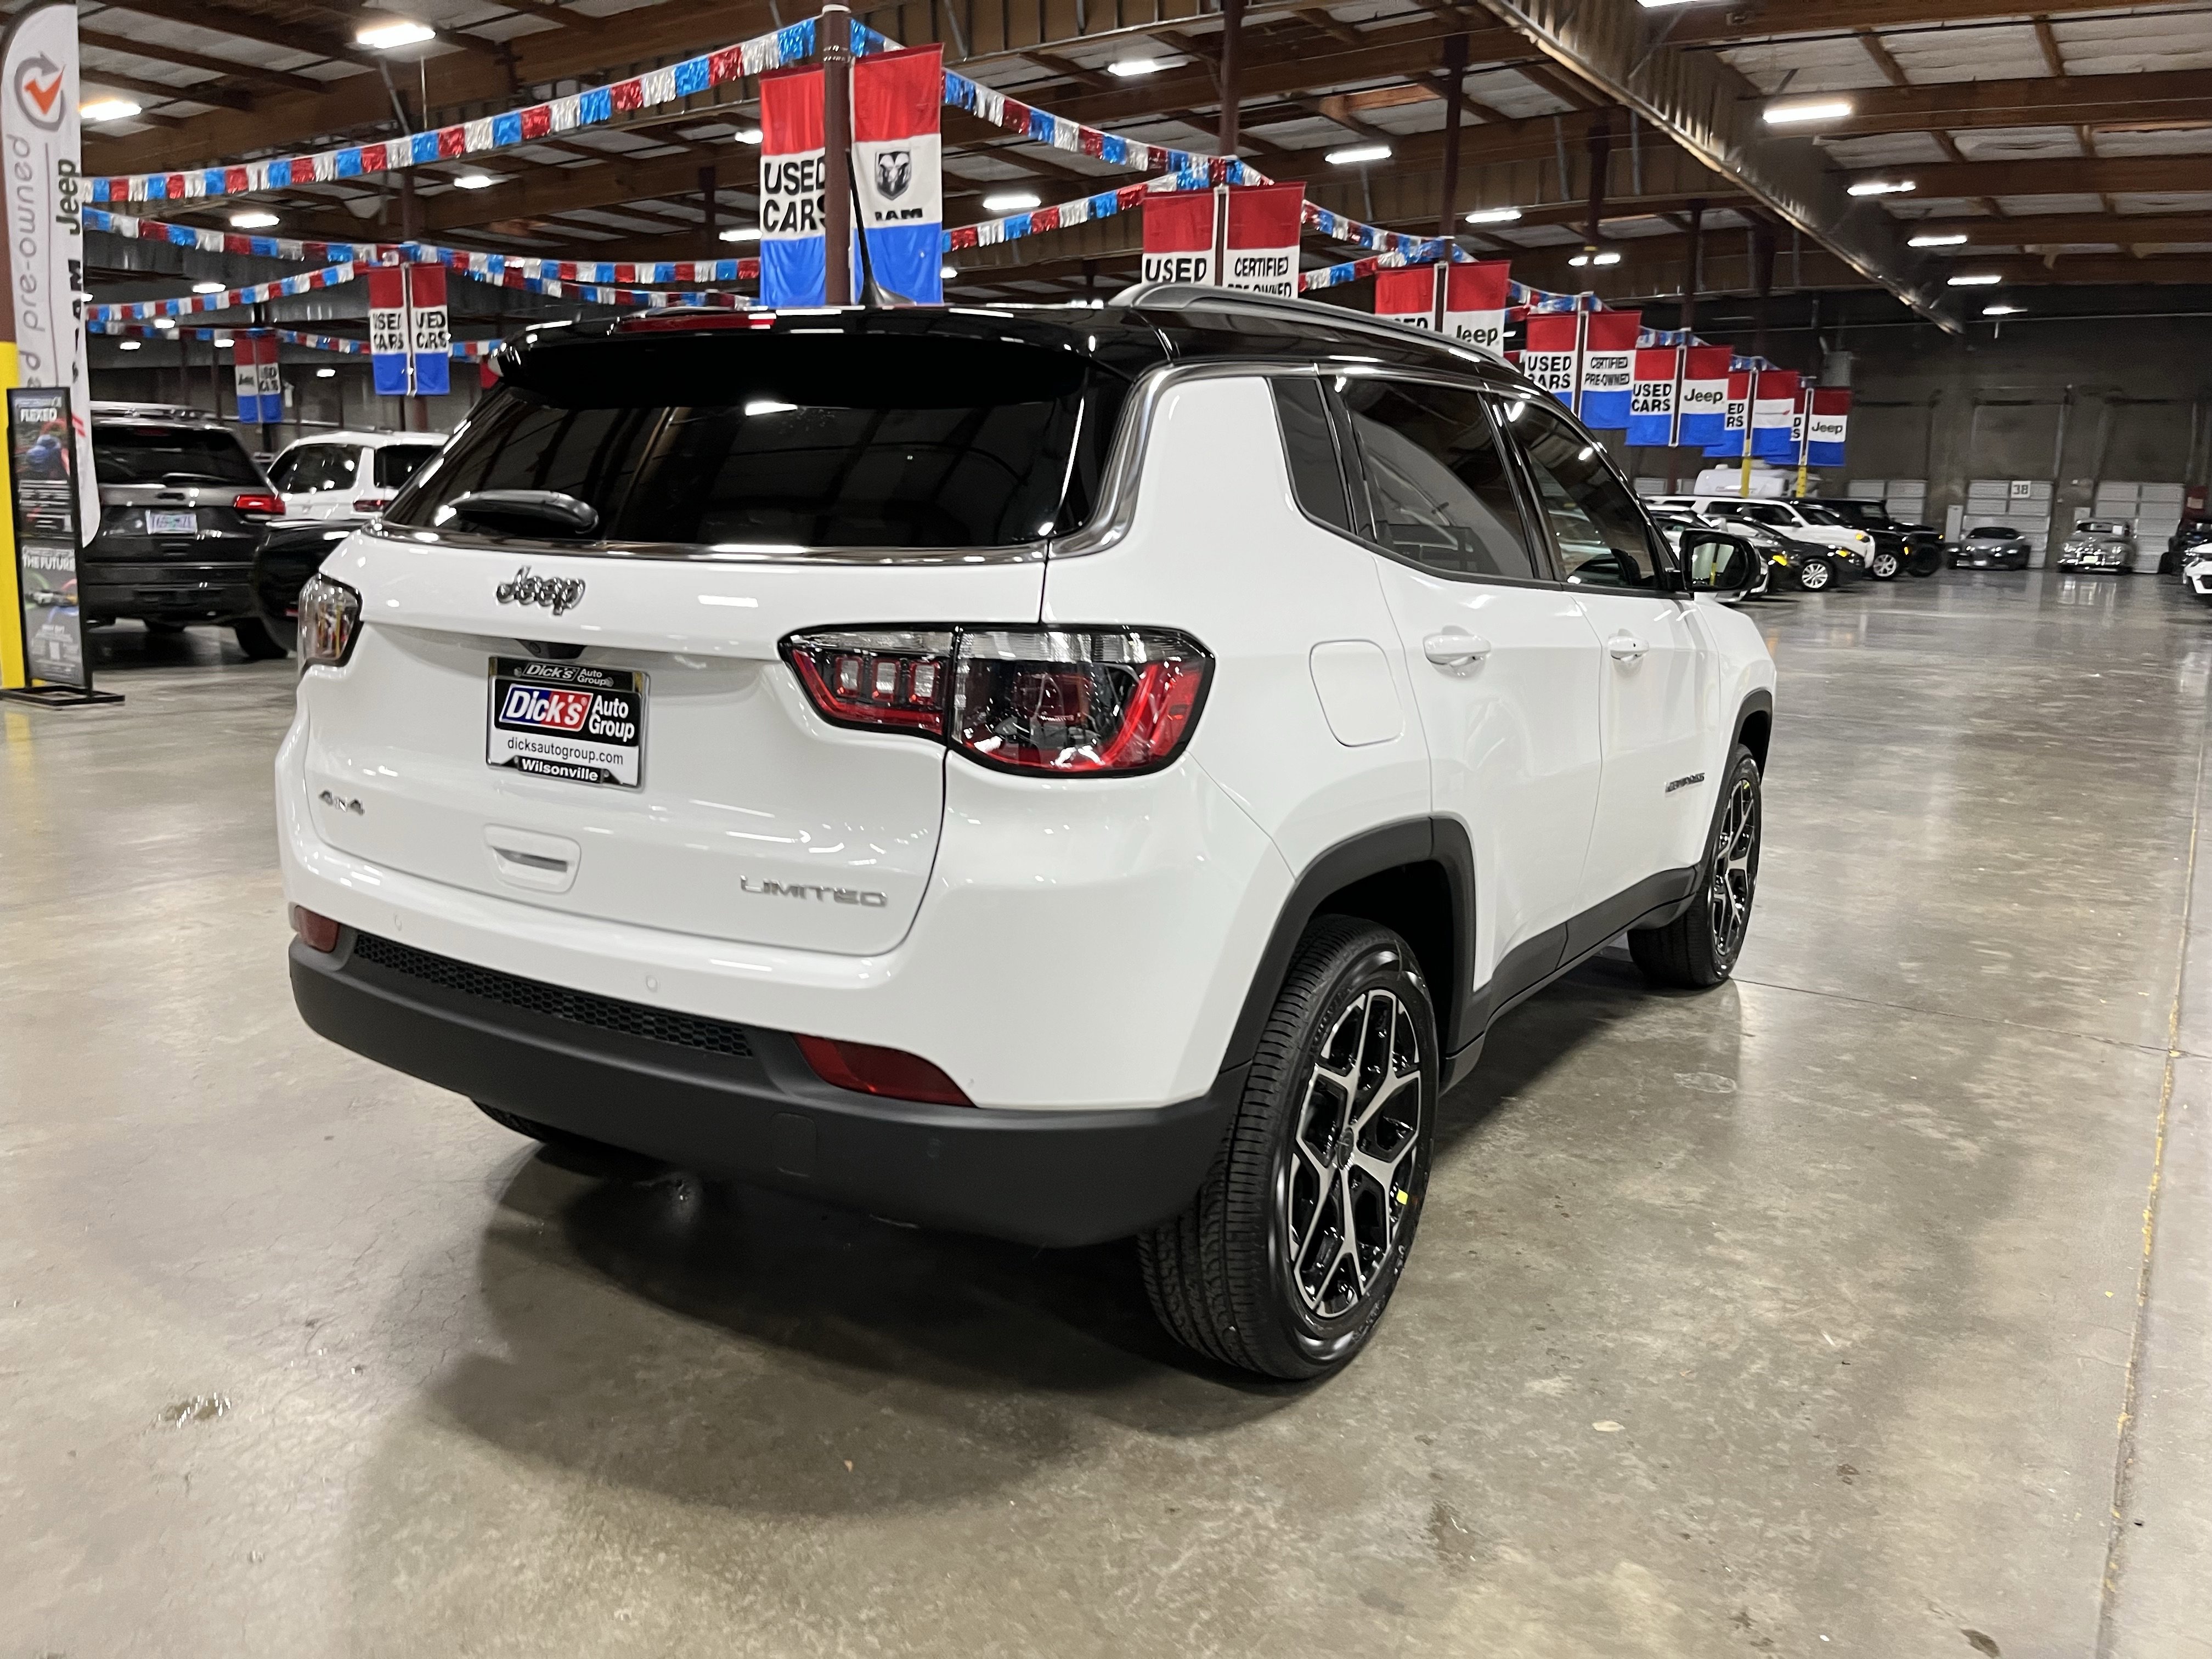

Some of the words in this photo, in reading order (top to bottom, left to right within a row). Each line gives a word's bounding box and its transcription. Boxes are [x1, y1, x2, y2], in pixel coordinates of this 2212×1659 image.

[55, 159, 81, 236] Jeep
[7, 134, 46, 332] pre-owned
[1145, 258, 1207, 283] USED
[1234, 256, 1289, 276] CERTIFIED
[68, 259, 81, 353] AM
[1528, 356, 1571, 371] USED
[1633, 383, 1672, 397] USED
[1684, 388, 1724, 404] Jeep
[1632, 398, 1671, 412] CARS
[1812, 421, 1843, 435] Jeep
[2013, 484, 2029, 494] 38
[496, 565, 586, 616] Jeep
[526, 664, 574, 679] Dick's
[577, 675, 607, 686] Group
[580, 669, 602, 678] Auto
[505, 690, 583, 725] Dick's
[592, 695, 629, 718] Auto
[588, 715, 635, 742] Group
[507, 737, 623, 765] dicksautogroup.com
[521, 758, 599, 781] Wilsonville
[740, 874, 888, 907] LIMITED
